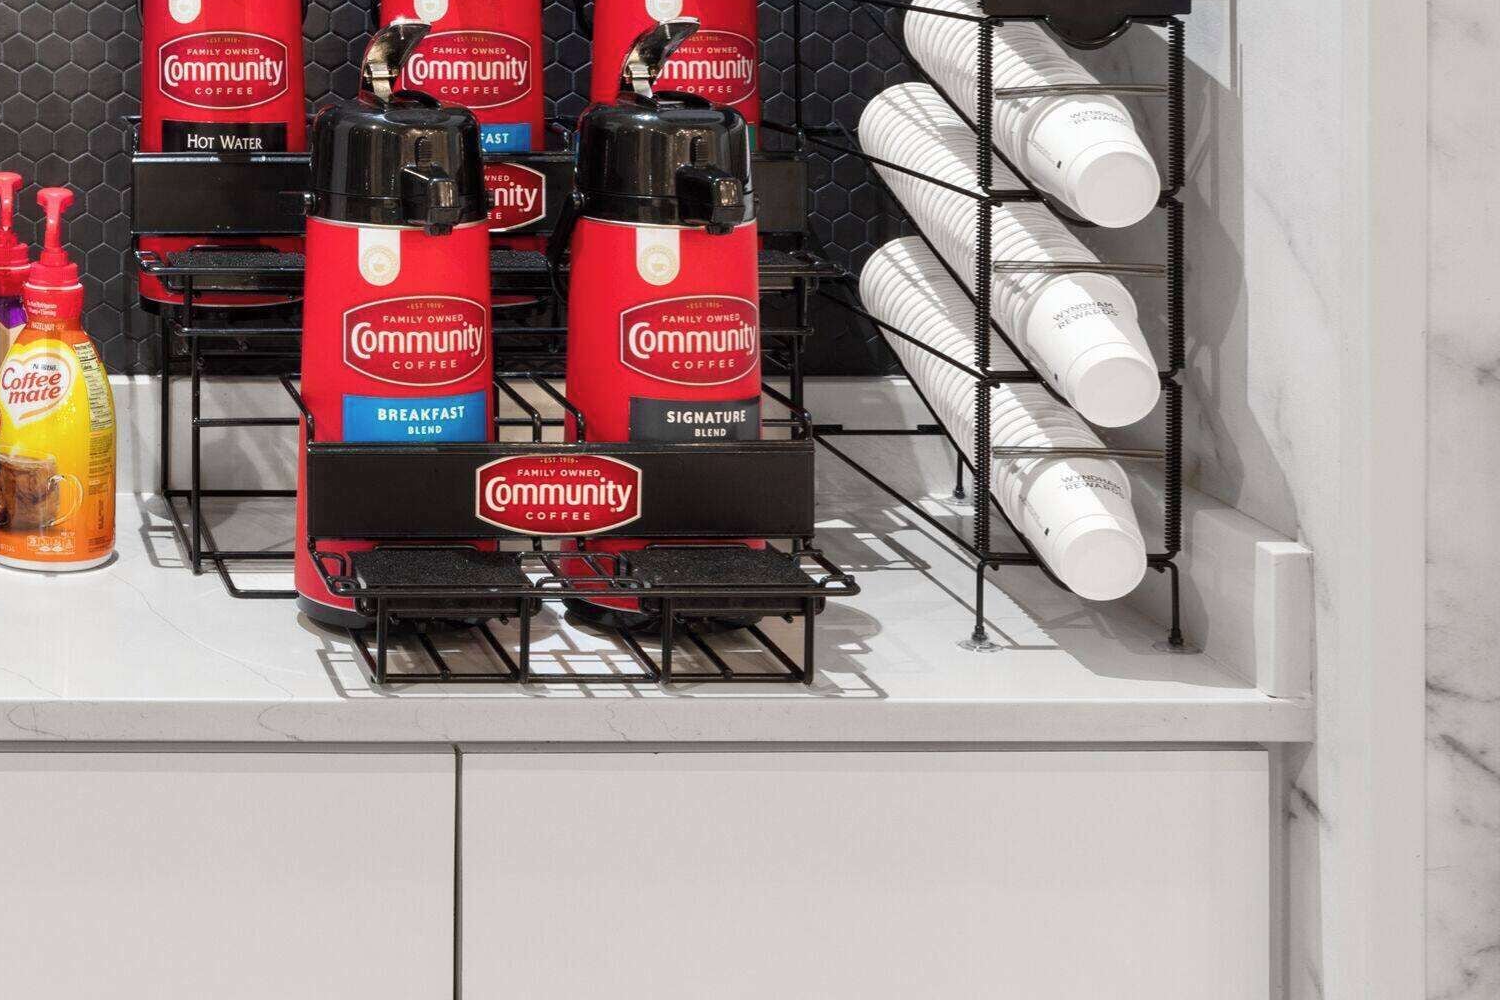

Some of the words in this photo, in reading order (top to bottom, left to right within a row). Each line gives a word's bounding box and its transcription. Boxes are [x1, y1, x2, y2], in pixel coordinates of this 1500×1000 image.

[164, 55, 284, 86] Community
[408, 54, 528, 86] Community
[653, 54, 754, 85] mmunity
[383, 315, 422, 324] FAMILY
[428, 314, 464, 323] OWNED
[662, 315, 702, 323] FAMILY
[707, 314, 740, 322] OWNED
[351, 321, 483, 359] Community
[629, 321, 756, 359] Community
[392, 360, 458, 370] COFFEE
[672, 359, 735, 370] COFFEE
[2, 367, 62, 390] Coffee
[9, 386, 61, 404] mate
[378, 406, 464, 421] BREAKFAST
[666, 410, 746, 424] SIGNATURE
[408, 426, 442, 435] BLEND
[695, 428, 726, 437] BLEND
[485, 476, 632, 512] Community
[525, 512, 590, 520] COFFEE
